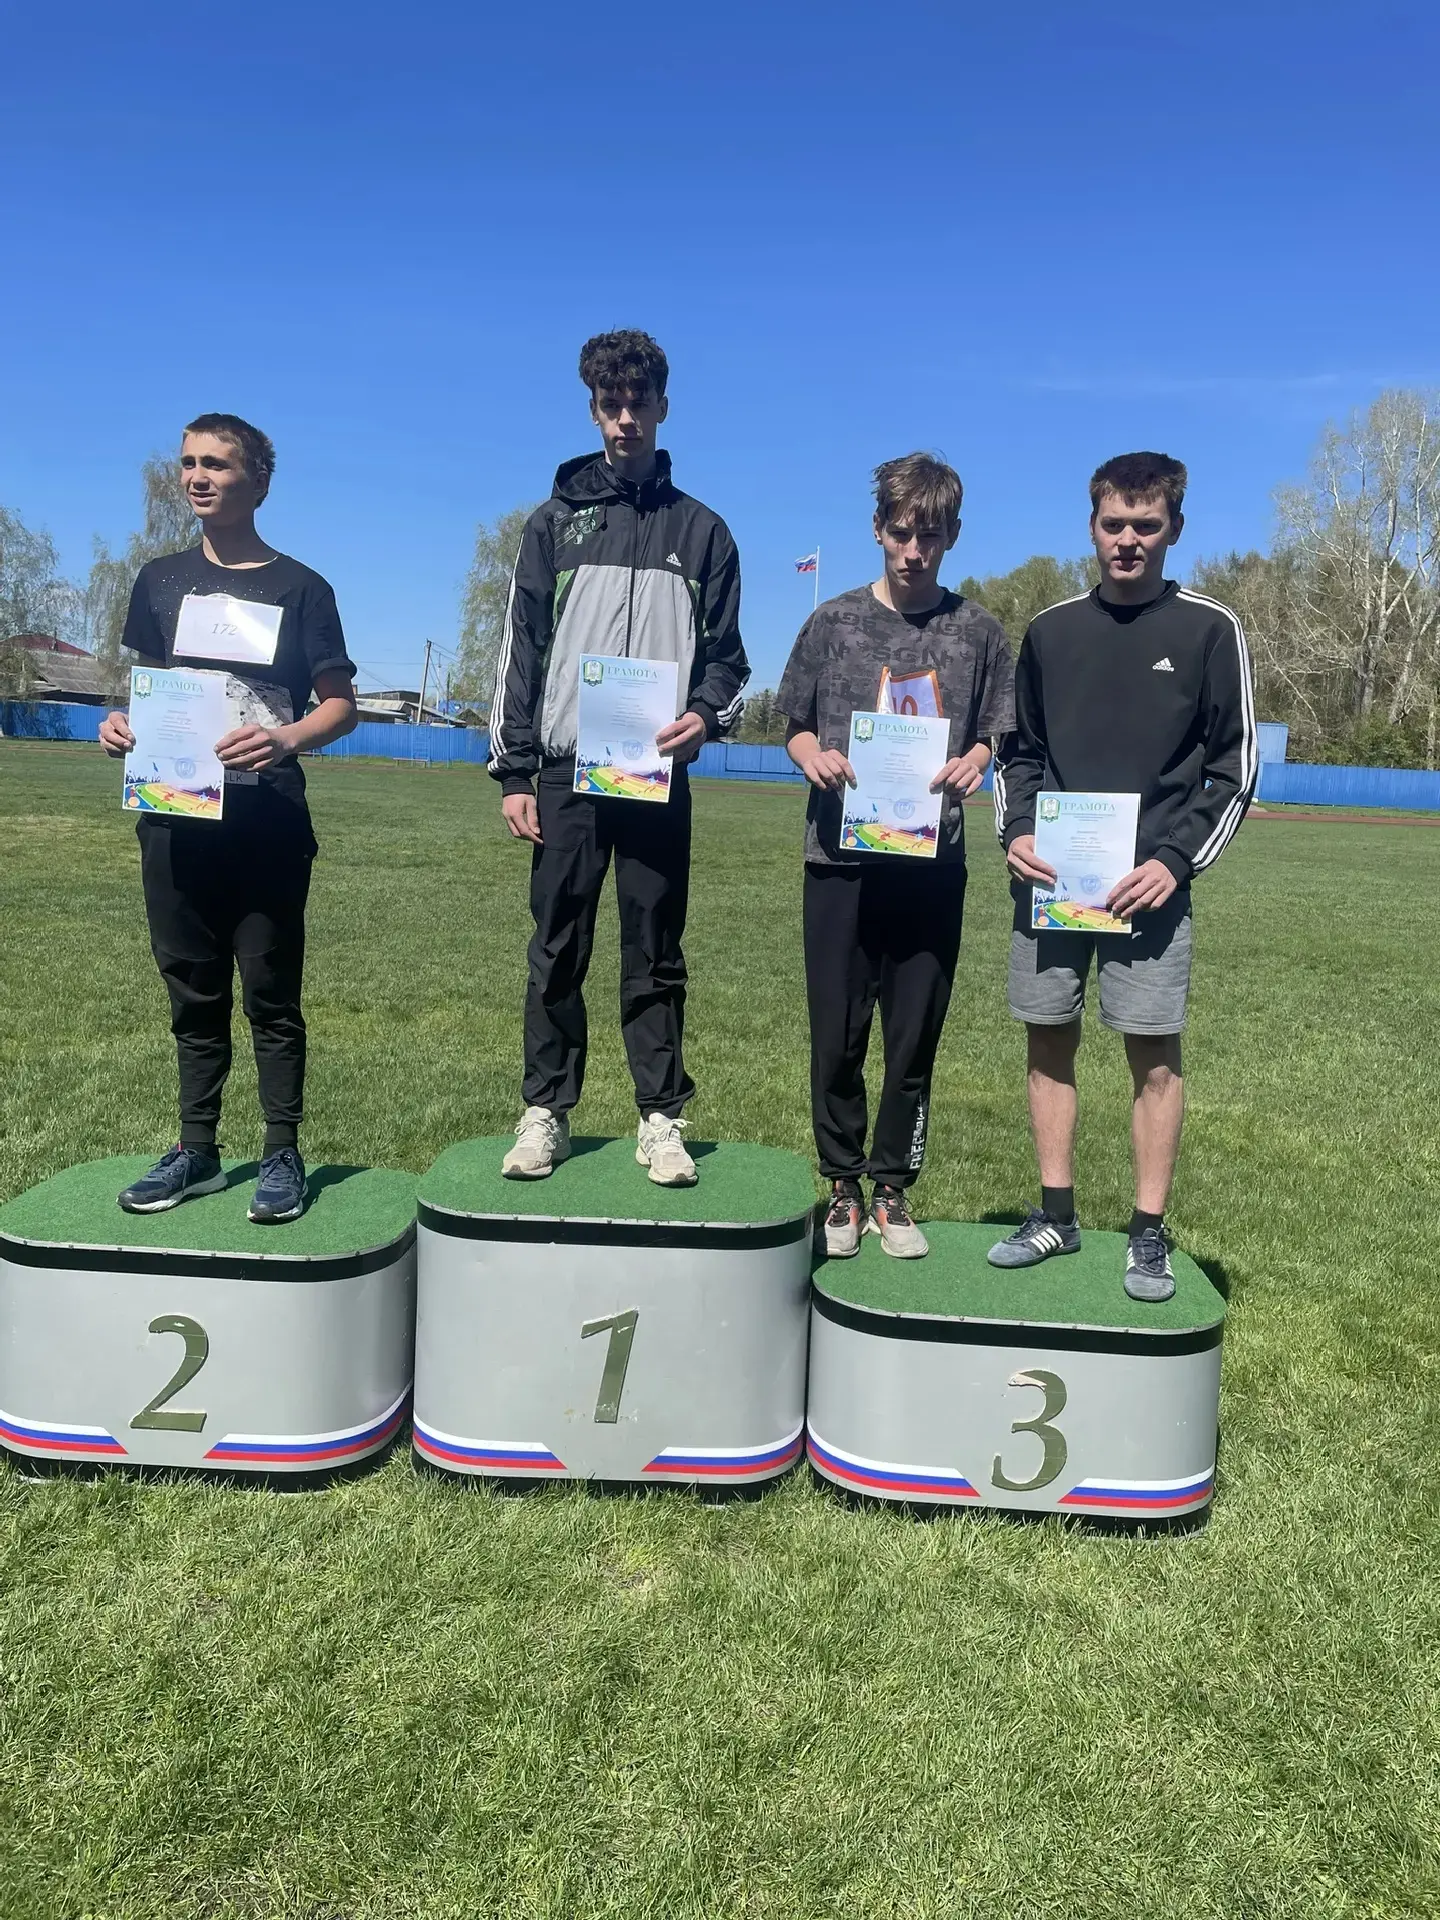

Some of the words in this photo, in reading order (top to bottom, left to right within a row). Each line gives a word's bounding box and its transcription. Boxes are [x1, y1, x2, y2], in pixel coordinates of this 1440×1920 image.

[211, 623, 238, 636] 172
[607, 666, 659, 679] ГРАМОТА
[155, 679, 204, 693] ГРАМОТА
[878, 723, 929, 736] ГРАМОТА
[1064, 802, 1116, 812] ГРАМОТА
[580, 1306, 639, 1424] 1
[129, 1313, 210, 1433] 2
[990, 1368, 1068, 1492] 3
